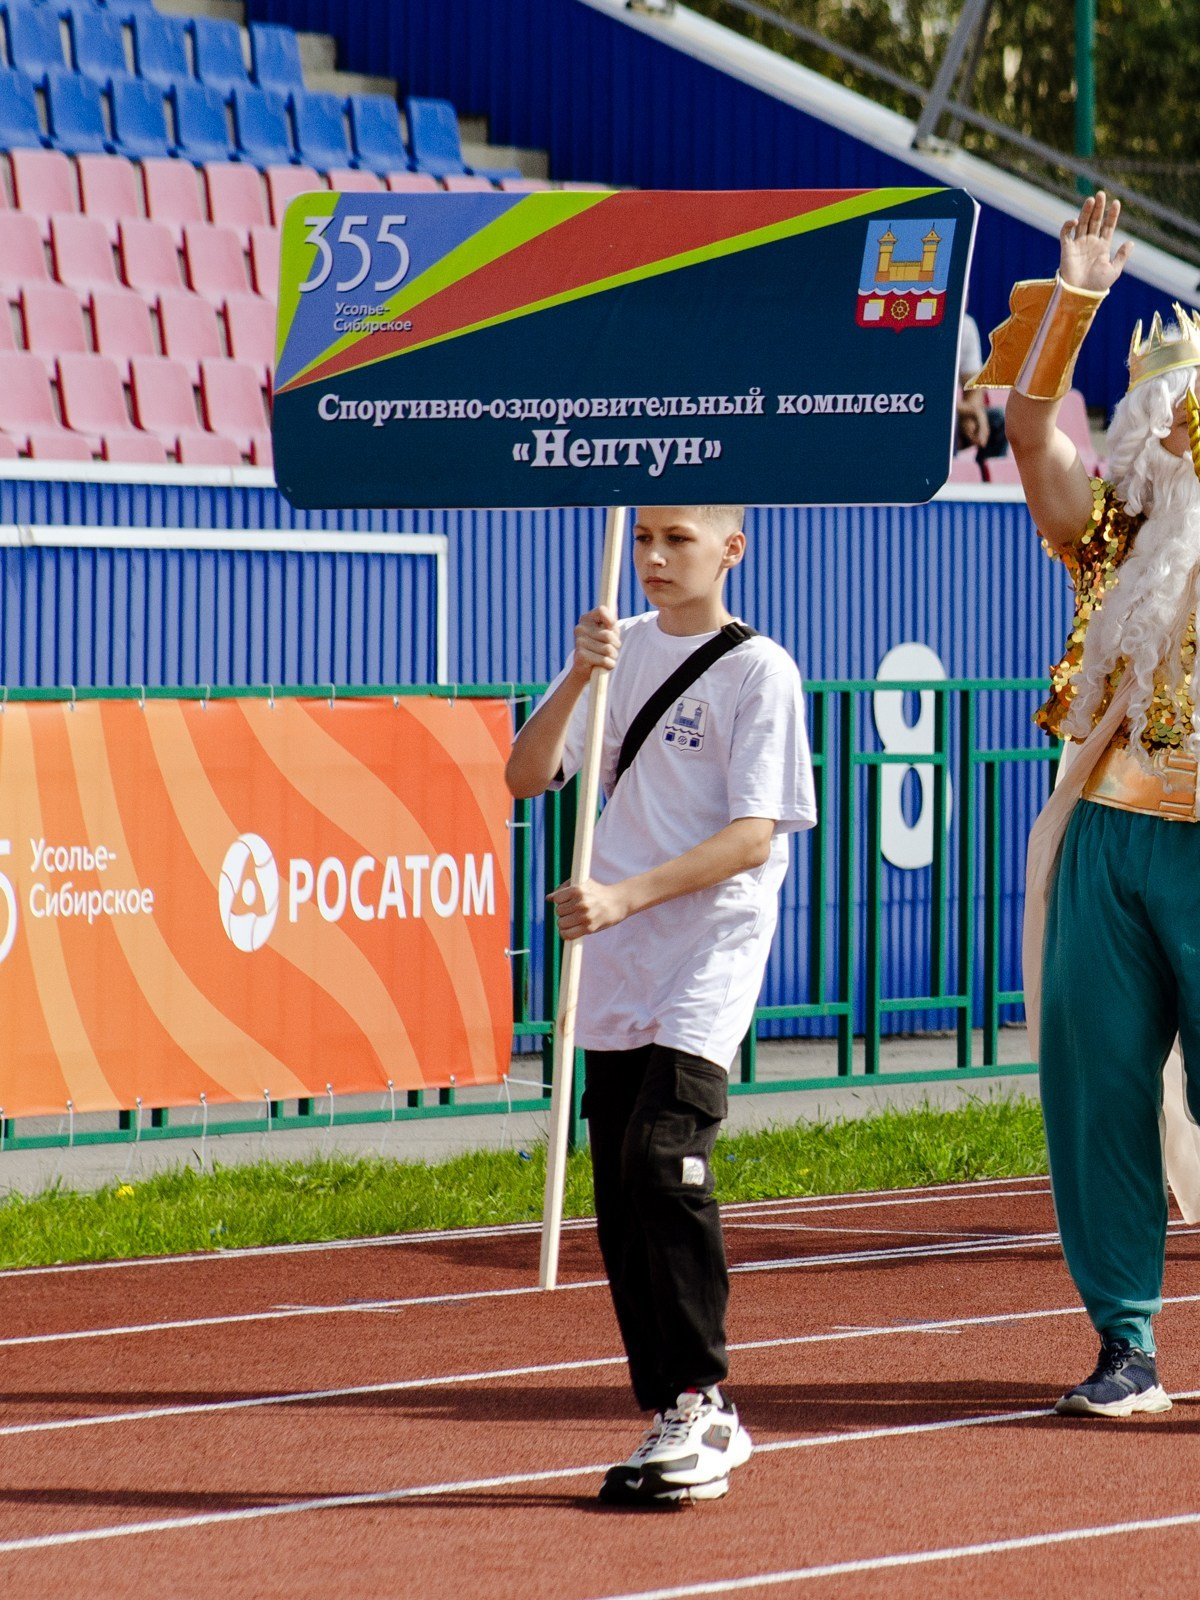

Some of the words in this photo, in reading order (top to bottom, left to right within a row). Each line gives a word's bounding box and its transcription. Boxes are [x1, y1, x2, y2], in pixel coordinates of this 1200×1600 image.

[298, 214, 410, 292] 355
[332, 318, 413, 334] Сибирское
[334, 302, 390, 316] Усолье-
[317, 387, 765, 426] Спортивно-оздоровительный
[776, 391, 925, 415] комплекс
[512, 428, 723, 477] «Нептун»
[29, 837, 117, 873] Усолье-
[28, 880, 155, 925] Сибирское
[288, 852, 496, 923] РОСАТОМ
